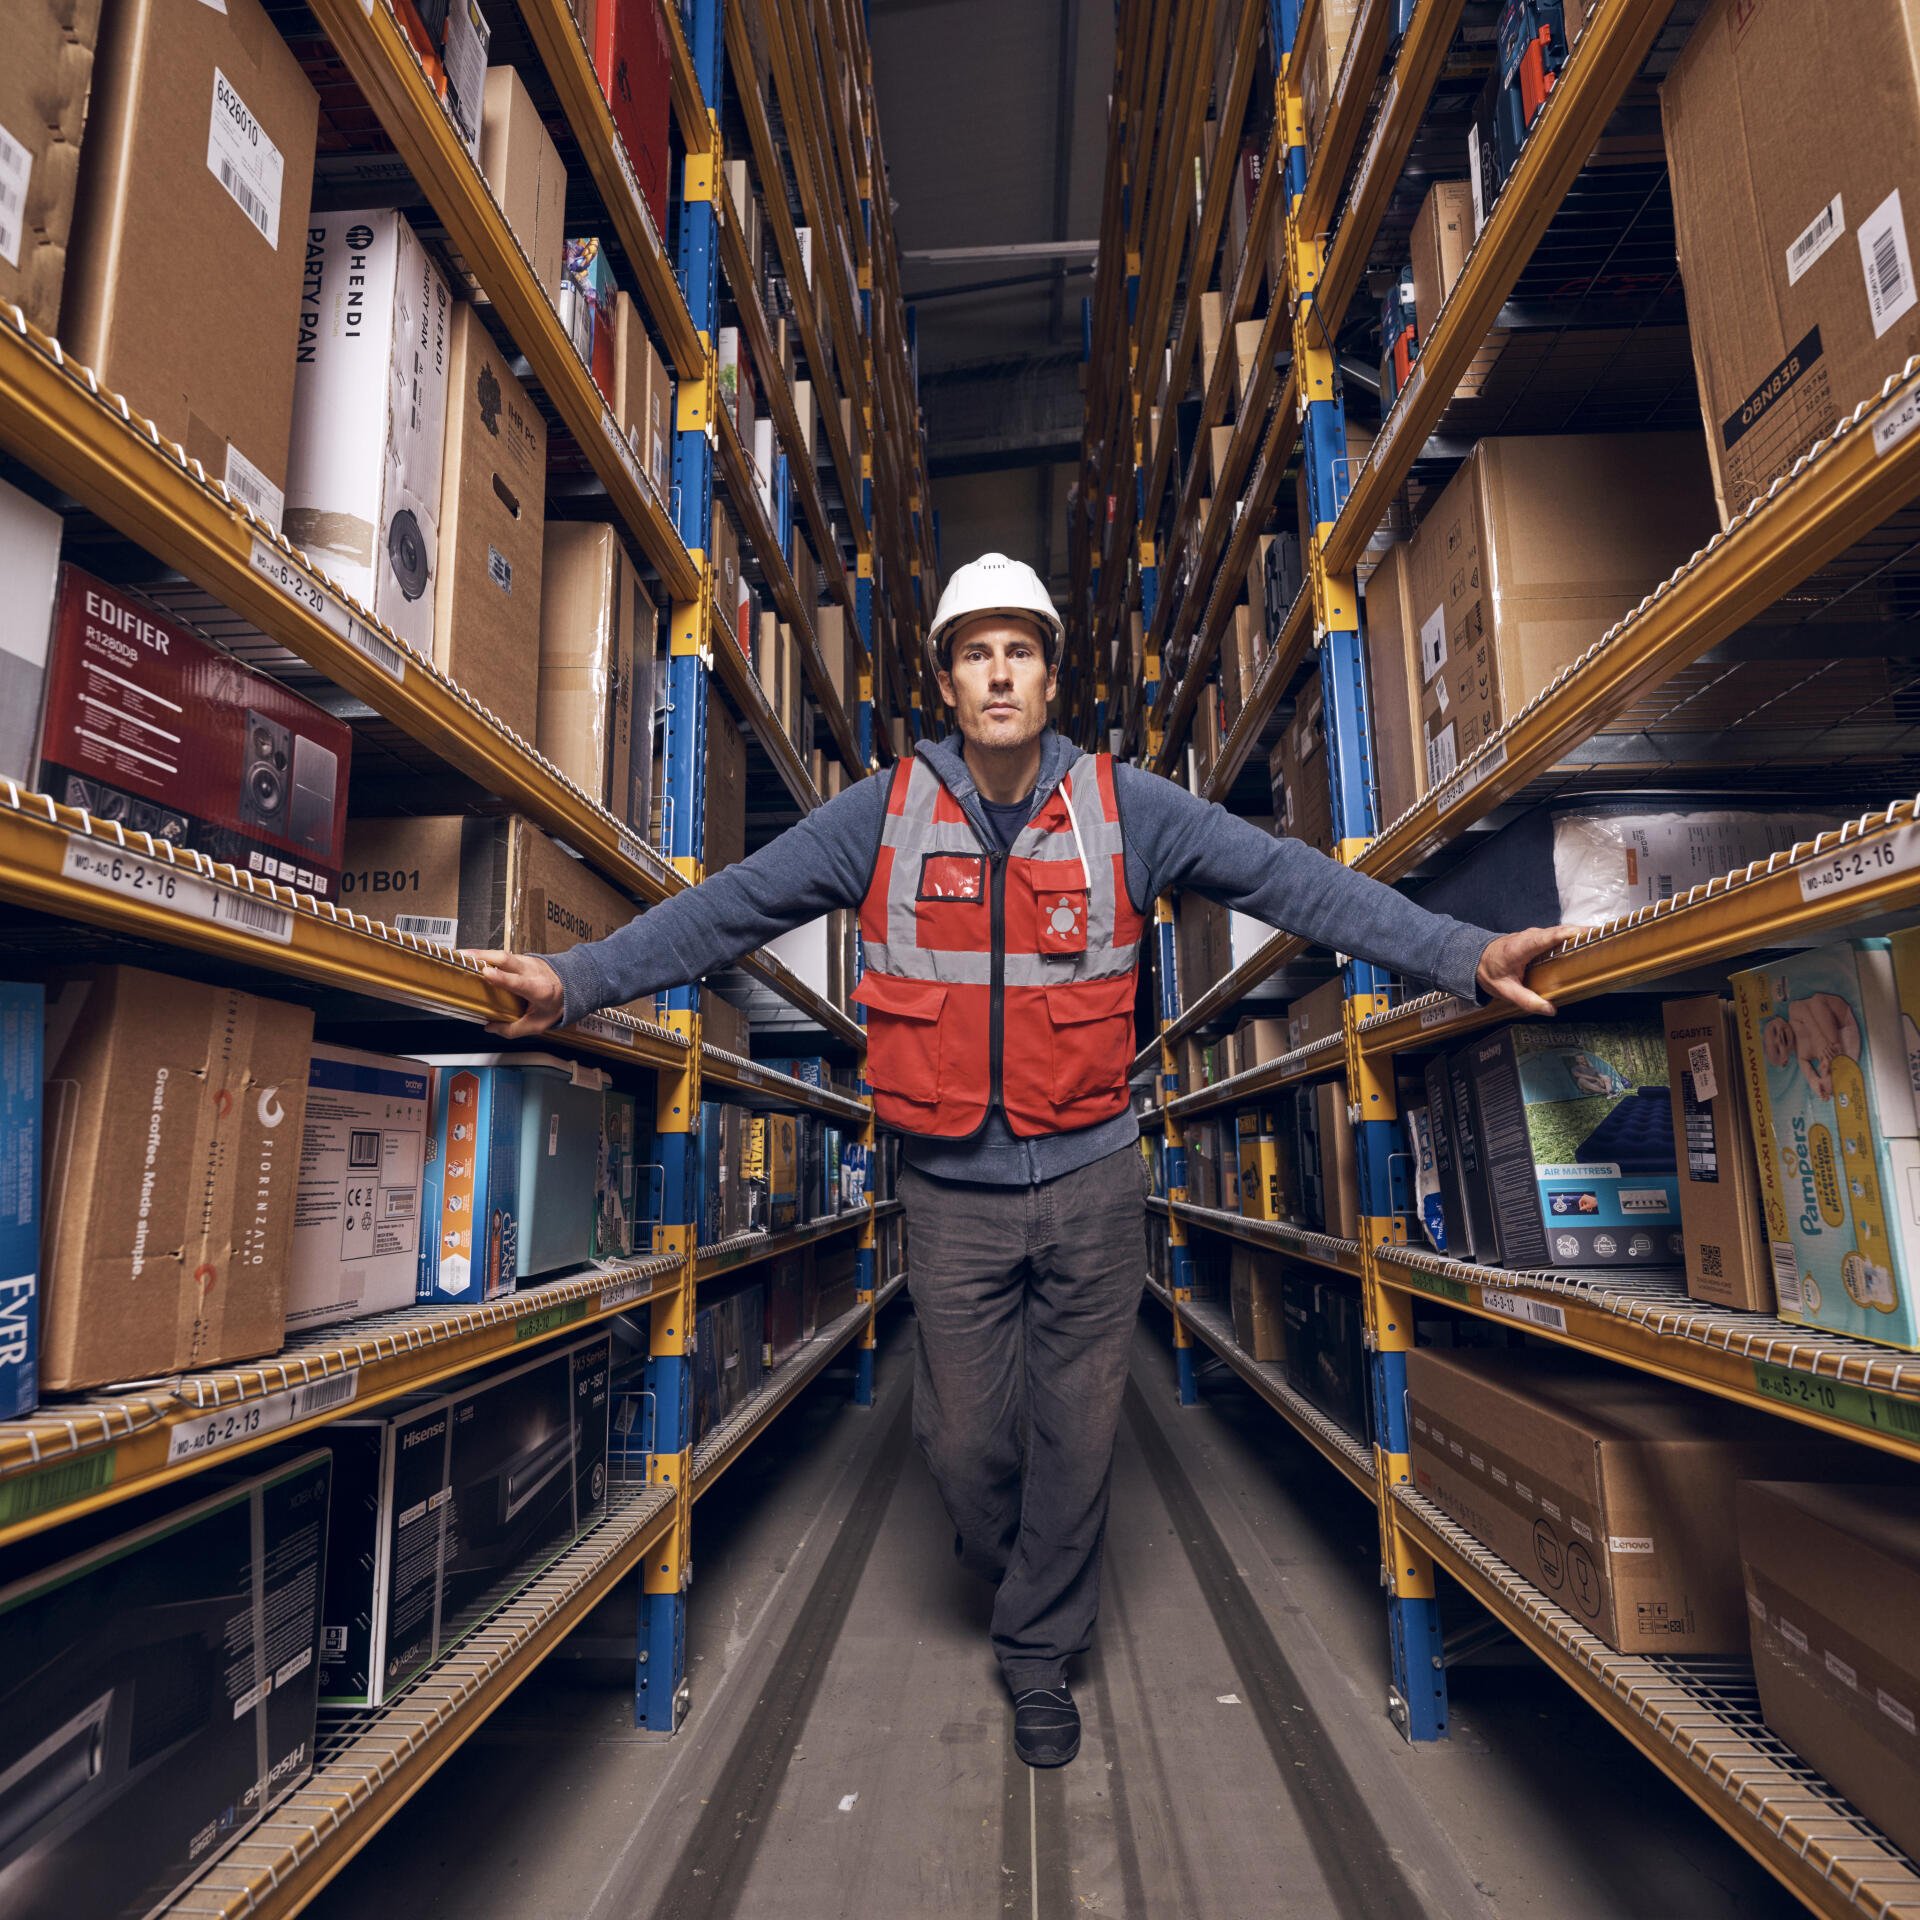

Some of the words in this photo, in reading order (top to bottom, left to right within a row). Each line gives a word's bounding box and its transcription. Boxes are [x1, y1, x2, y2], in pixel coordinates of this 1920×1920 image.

[217, 79, 258, 147] 6426010
[302, 227, 326, 305] PARTY
[423, 259, 431, 314] PARTY
[345, 255, 366, 338] HENDI
[297, 312, 318, 363] PAN
[420, 313, 430, 350] PAN
[436, 307, 445, 376] HENDI
[1740, 357, 1800, 425] OBN83B
[508, 400, 524, 434] IHR
[525, 429, 537, 451] PC
[86, 592, 170, 656] EDIFIER
[86, 625, 139, 662] R1280DB
[547, 900, 593, 942] BBC901B01
[1520, 1031, 1585, 1046] Bestway
[1670, 1026, 1713, 1040] GIGABYTE
[151, 1068, 170, 1117] Great
[1746, 1044, 1769, 1138] ECONOMY
[145, 1115, 163, 1169] coffee.
[1760, 1142, 1776, 1190] MAXI
[138, 1171, 159, 1218] Made
[200, 1140, 218, 1234] FIORENZATO
[1543, 1168, 1560, 1176] AIR
[1561, 1166, 1613, 1176] MATTRESS
[1791, 1116, 1822, 1237] Pampers
[1815, 1144, 1832, 1207] premium
[1822, 1135, 1840, 1214] protection
[252, 1139, 273, 1266] FIORENZATO
[130, 1220, 150, 1280] simple.
[501, 1211, 513, 1279] CLEAN
[508, 1220, 518, 1271] EVER
[402, 1421, 446, 1451] Hisense
[1613, 1540, 1650, 1549] Lenovo
[244, 1742, 305, 1806] Hisense
